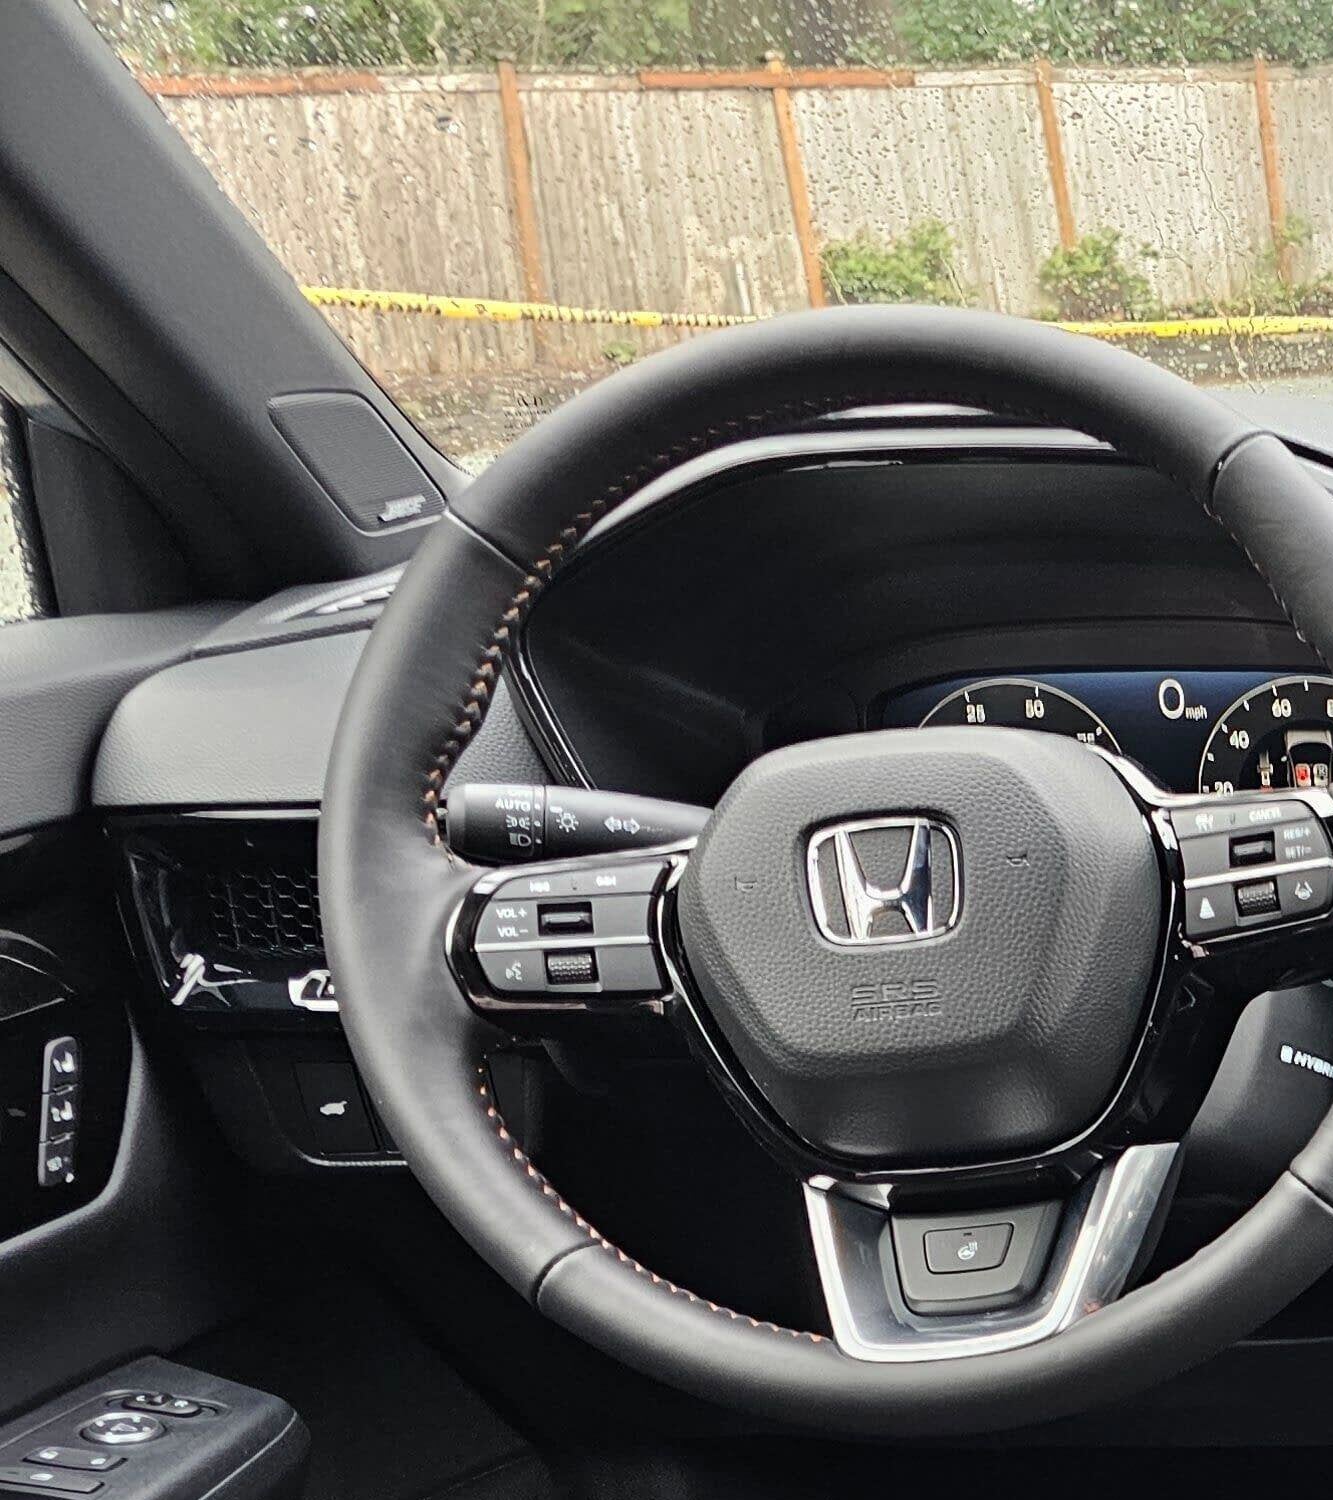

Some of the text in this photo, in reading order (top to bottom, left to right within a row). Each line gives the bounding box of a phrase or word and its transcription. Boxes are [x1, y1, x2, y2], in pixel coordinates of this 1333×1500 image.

[1158, 678, 1208, 721] 0 mph
[1230, 730, 1250, 749] 40
[495, 798, 531, 812] AUTO
[496, 907, 518, 919] VOL
[497, 926, 519, 938] VOL
[851, 981, 939, 1002] SRS
[852, 1002, 942, 1022] AIRBAG
